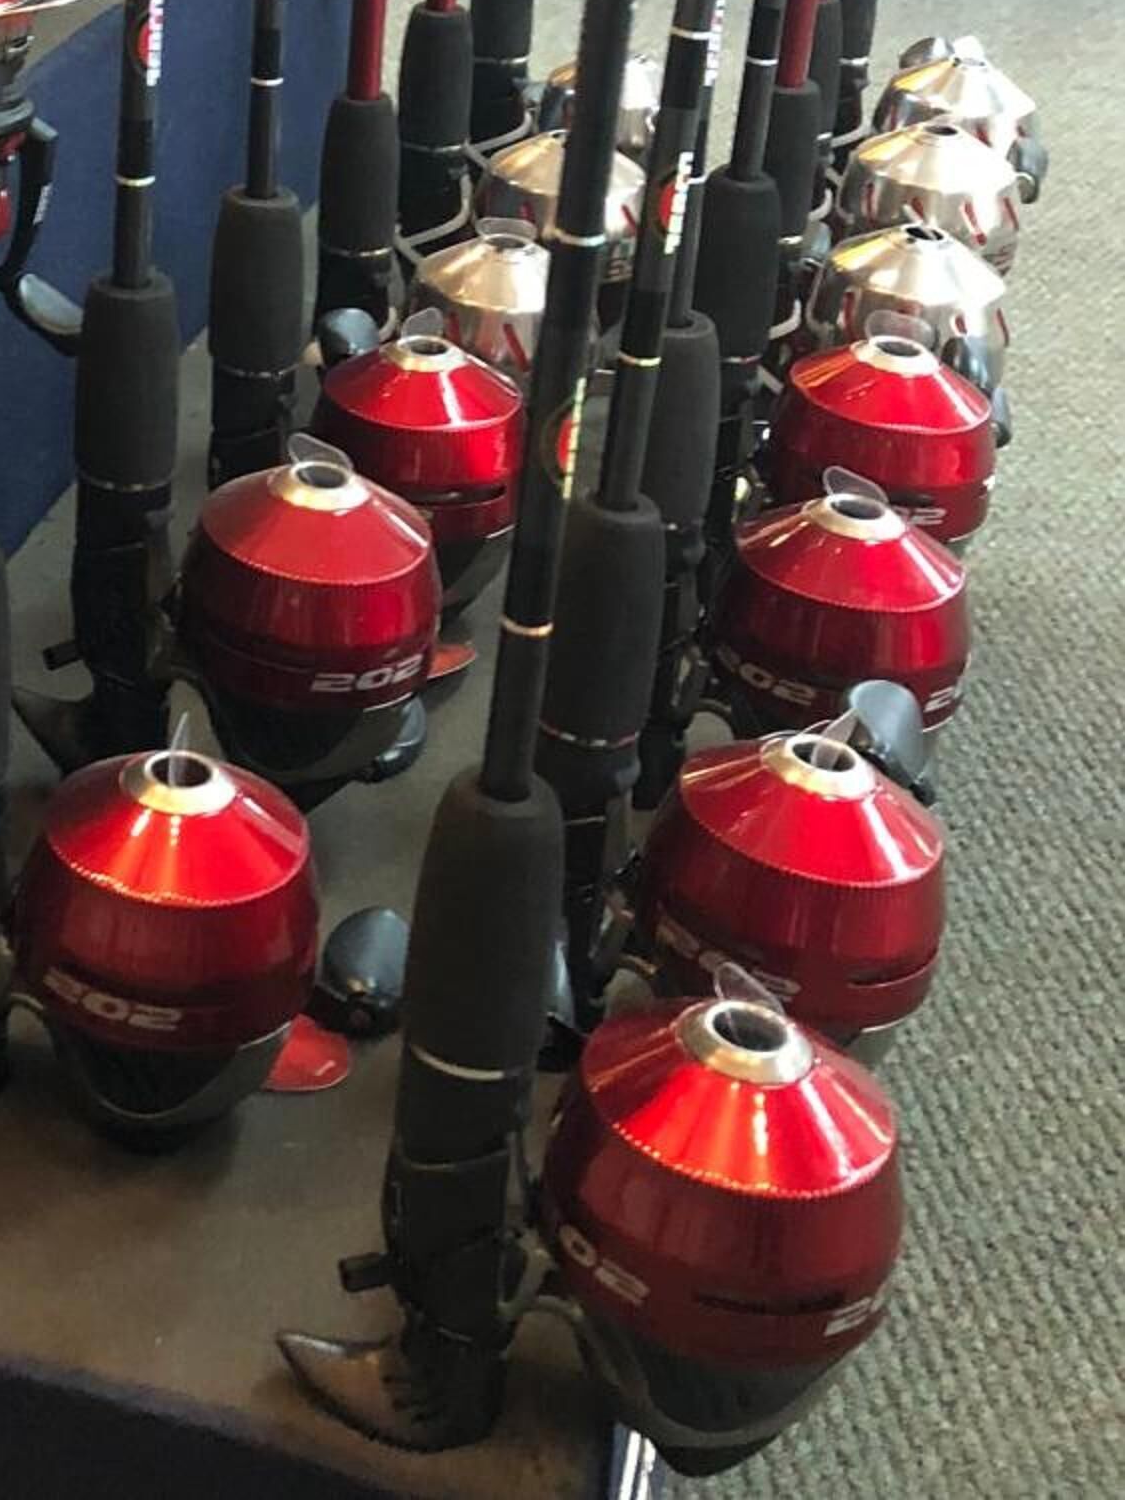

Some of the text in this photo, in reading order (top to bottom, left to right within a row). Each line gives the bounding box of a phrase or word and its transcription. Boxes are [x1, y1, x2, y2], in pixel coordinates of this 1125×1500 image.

[311, 652, 425, 694] 202
[42, 964, 184, 1032] 202
[559, 1224, 651, 1307] 02
